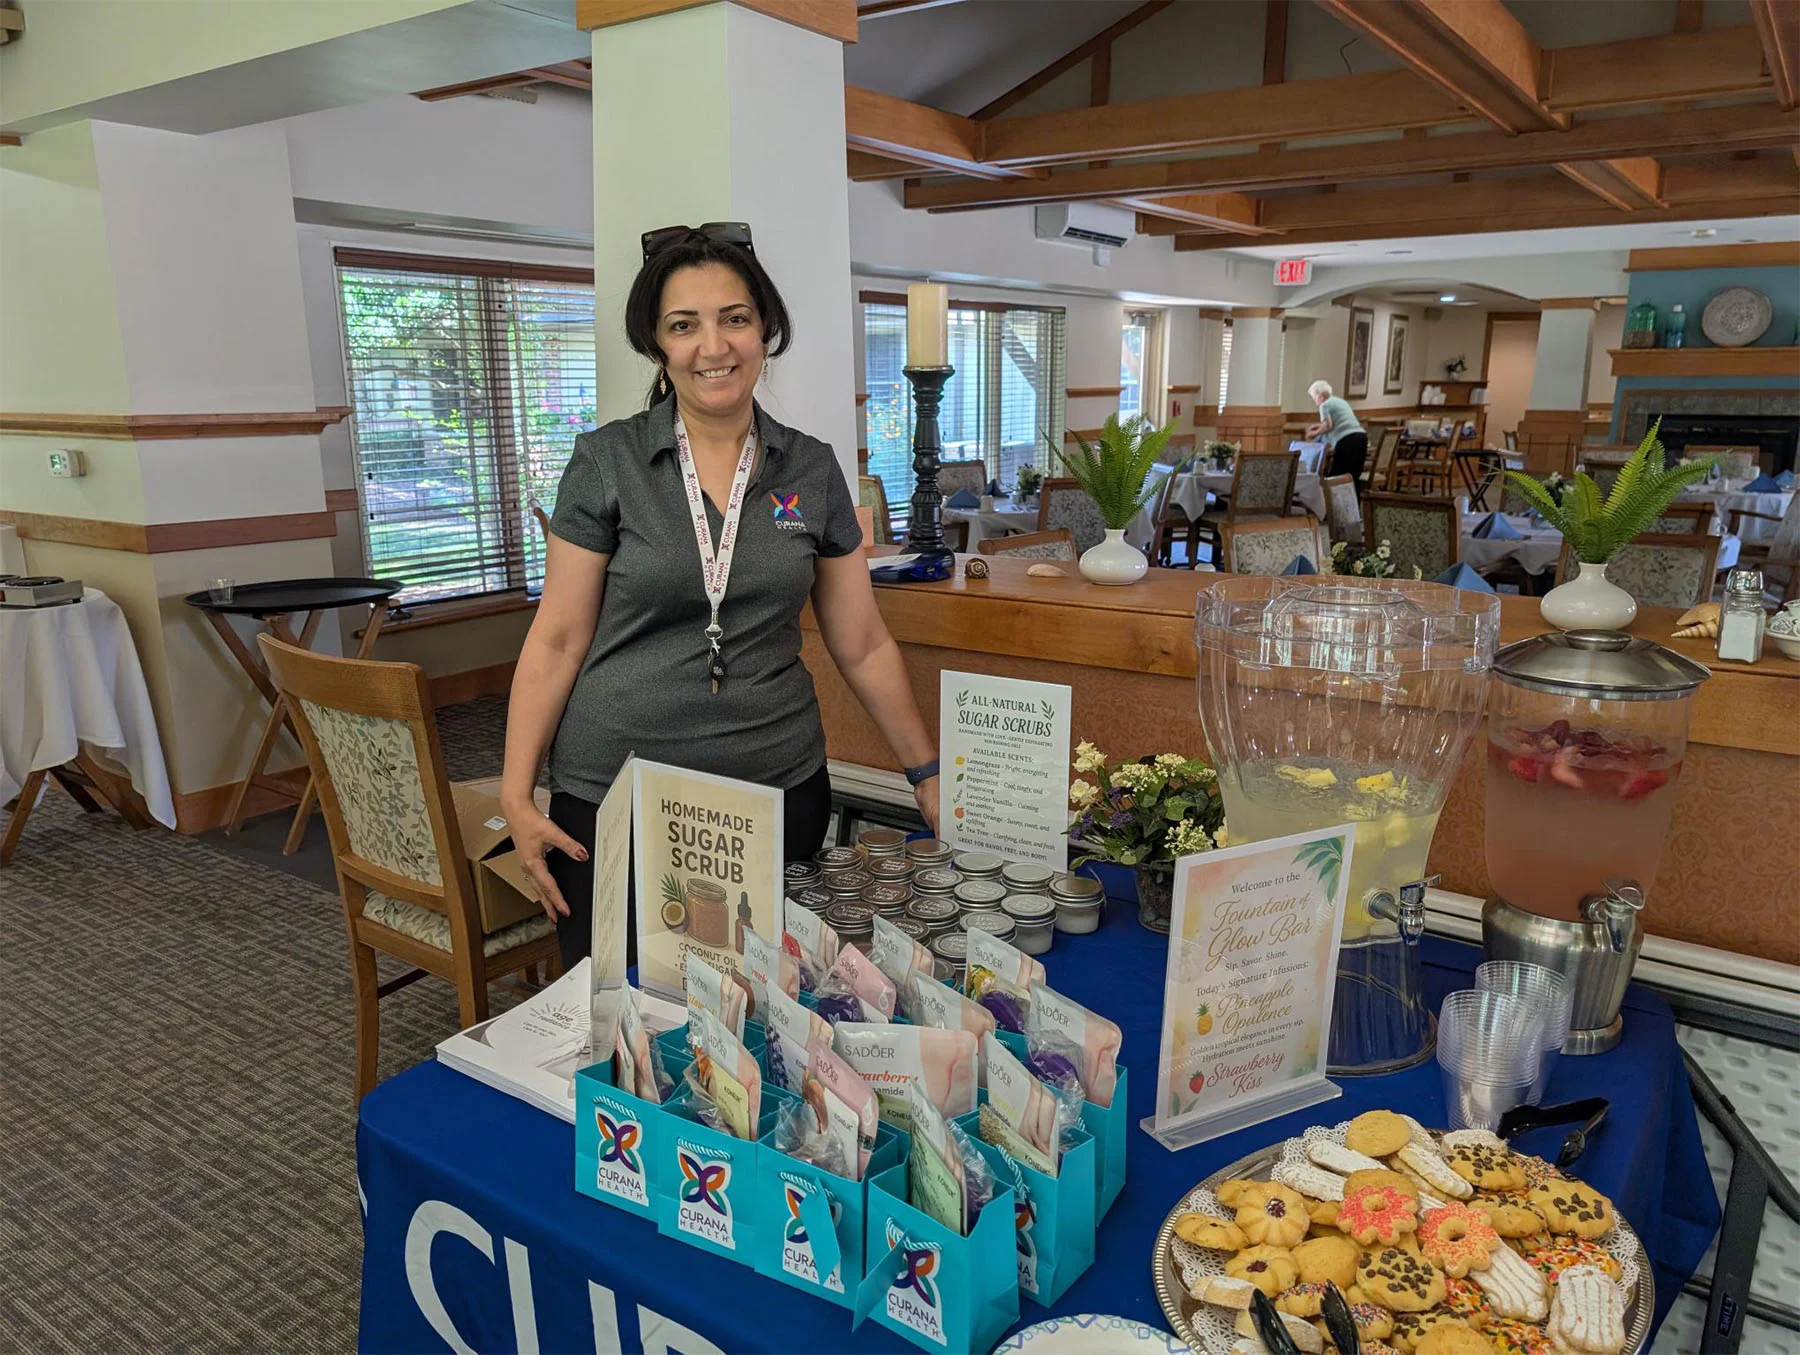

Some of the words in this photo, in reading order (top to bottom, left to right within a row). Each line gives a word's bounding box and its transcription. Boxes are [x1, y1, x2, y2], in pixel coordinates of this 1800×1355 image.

[1279, 260, 1306, 283] EXIT
[724, 521, 733, 544] CURANA
[715, 562, 724, 586] CURANA
[971, 695, 1037, 714] ALL-NATURAL
[958, 709, 999, 729] SUGAR
[1001, 716, 1053, 737] SCRUBS
[966, 757, 1000, 769] Lemongrass
[972, 747, 1006, 759] AVAILABLE
[1007, 753, 1034, 764] SCENTS:
[966, 775, 999, 787] Peppermint
[966, 792, 992, 803] Lavender
[992, 797, 1013, 807] Vanilla
[661, 798, 754, 834] HOMEMADE
[966, 809, 982, 819] Sweet
[982, 811, 1003, 823] Orange
[1039, 824, 1050, 832] and
[668, 820, 745, 860] SUGAR
[957, 836, 973, 845] GREAT
[966, 826, 976, 834] Tea
[976, 828, 989, 836] Tree
[1033, 840, 1043, 848] and
[671, 847, 744, 884] SCRUB
[1231, 879, 1272, 894] Welcome
[1274, 876, 1284, 885] to
[1286, 872, 1301, 883] the
[1210, 894, 1297, 932] Fountain
[1205, 926, 1265, 972] Glow
[1268, 913, 1313, 946] Bar
[678, 942, 722, 962] COCONUT
[723, 956, 738, 968] OIL
[1265, 950, 1288, 961] Shine.
[1196, 981, 1226, 997] Today's
[1228, 971, 1268, 988] Signature
[1268, 961, 1309, 978] Infusions:
[1216, 978, 1294, 1019] Pineapple
[552, 1012, 573, 1022] age
[1222, 1004, 1292, 1036] Opulence
[1190, 1043, 1214, 1056] Golden
[1215, 1036, 1240, 1050] tropical
[1240, 1029, 1268, 1043] elegance
[1268, 1026, 1275, 1034] in
[1275, 1021, 1293, 1033] every
[1202, 1048, 1236, 1063] Hydration
[1236, 1043, 1255, 1053] meets
[1206, 1051, 1285, 1088] Strawberry
[1228, 1072, 1264, 1098] Kiss
[598, 1166, 642, 1191] CURANA
[598, 1179, 643, 1200] HEALTH
[679, 1219, 729, 1243] HEALTH
[680, 1207, 728, 1234] CURANA
[888, 1293, 938, 1329] CURANA
[888, 1305, 940, 1338] HEALTH
